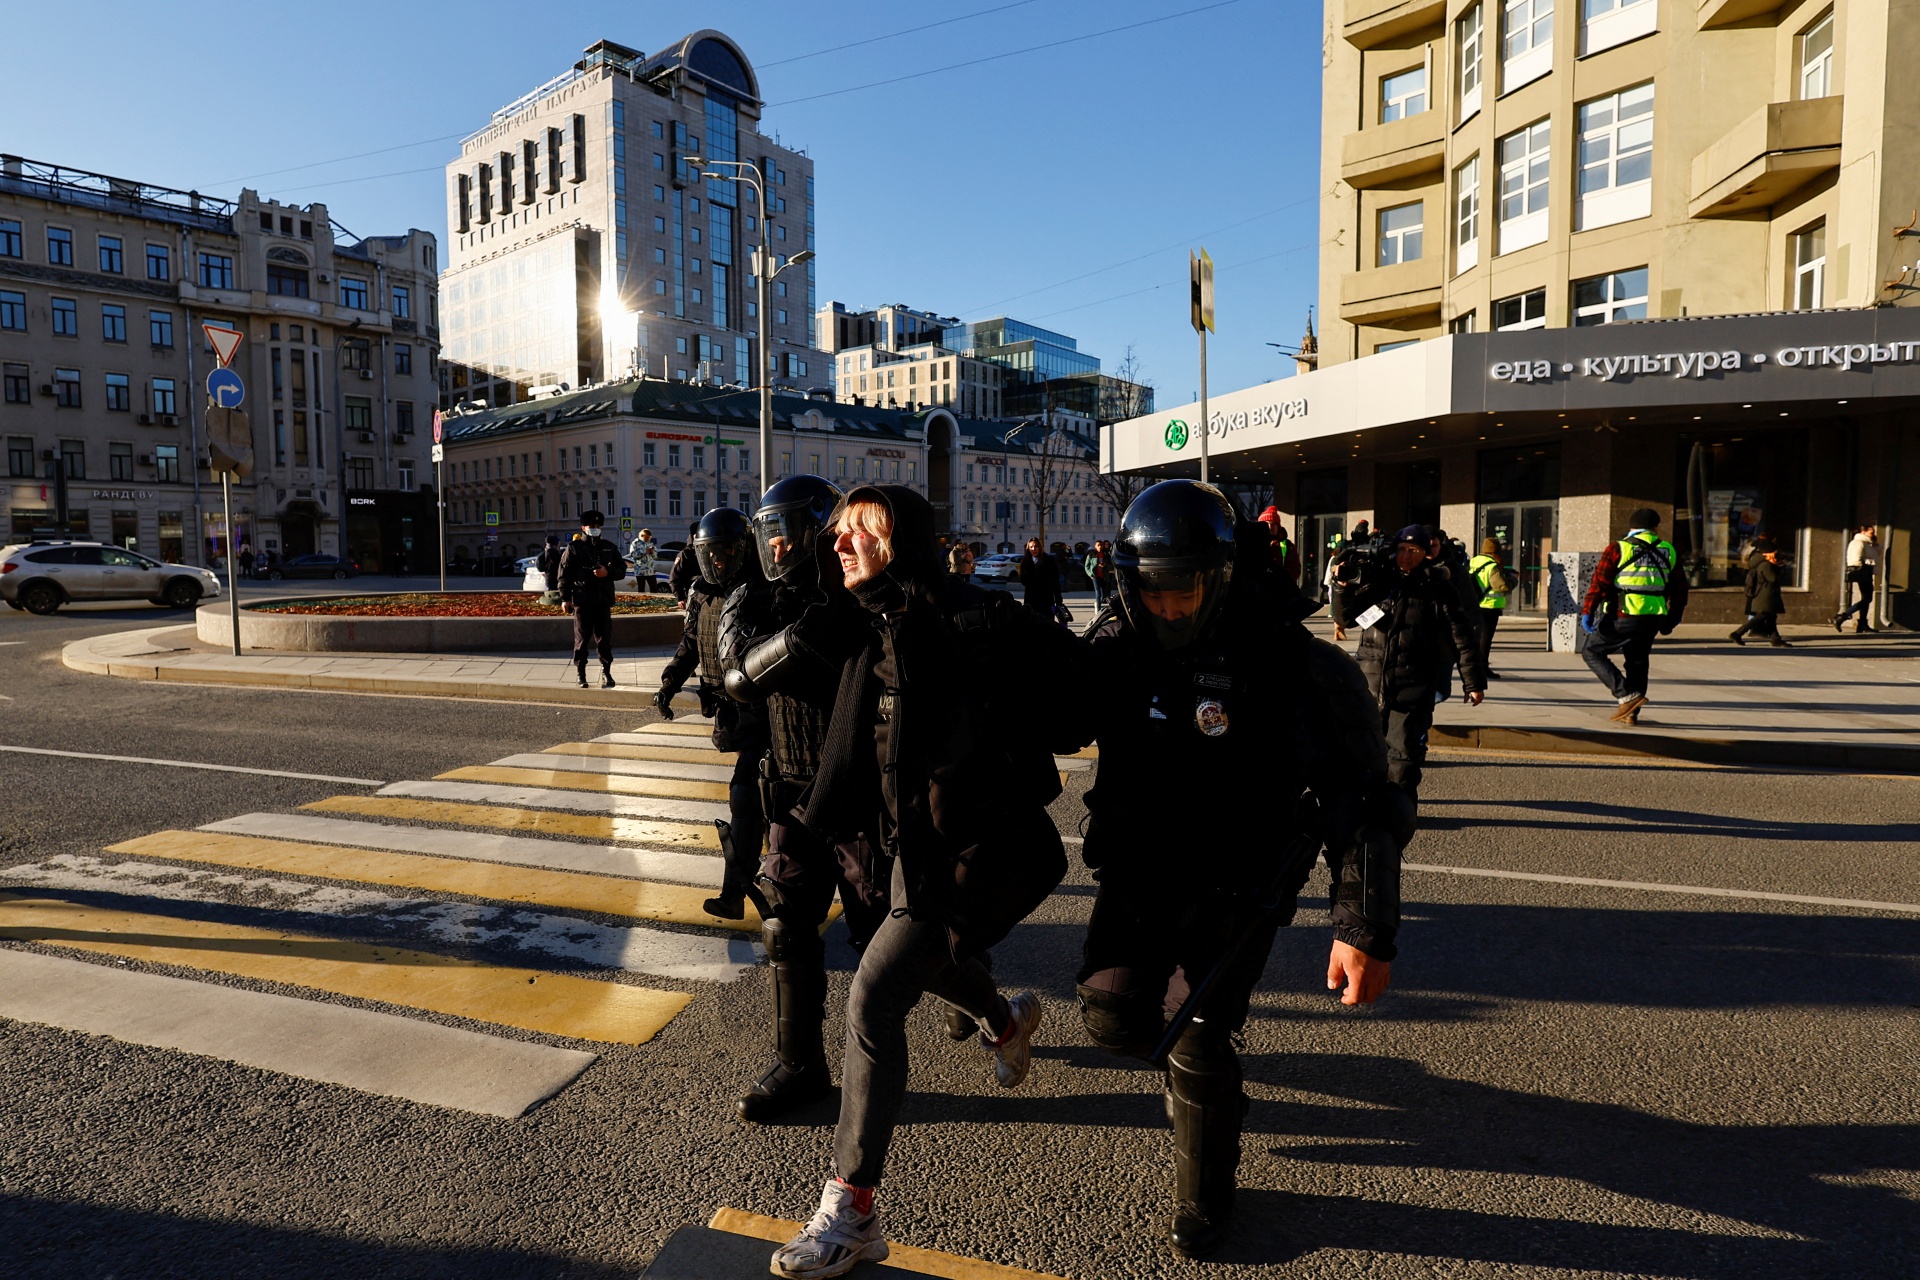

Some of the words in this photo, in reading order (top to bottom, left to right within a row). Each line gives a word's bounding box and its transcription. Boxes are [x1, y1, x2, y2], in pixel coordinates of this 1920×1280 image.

[1491, 359, 1552, 382] еда
[1584, 350, 1742, 381] культура
[1777, 341, 1920, 370] открыт
[1192, 411, 1248, 438] абука
[1251, 398, 1308, 427] вкуса
[646, 432, 702, 442] EUROSPAR
[975, 456, 1007, 466] ARTICO
[93, 490, 154, 499] РАНДЕВУ
